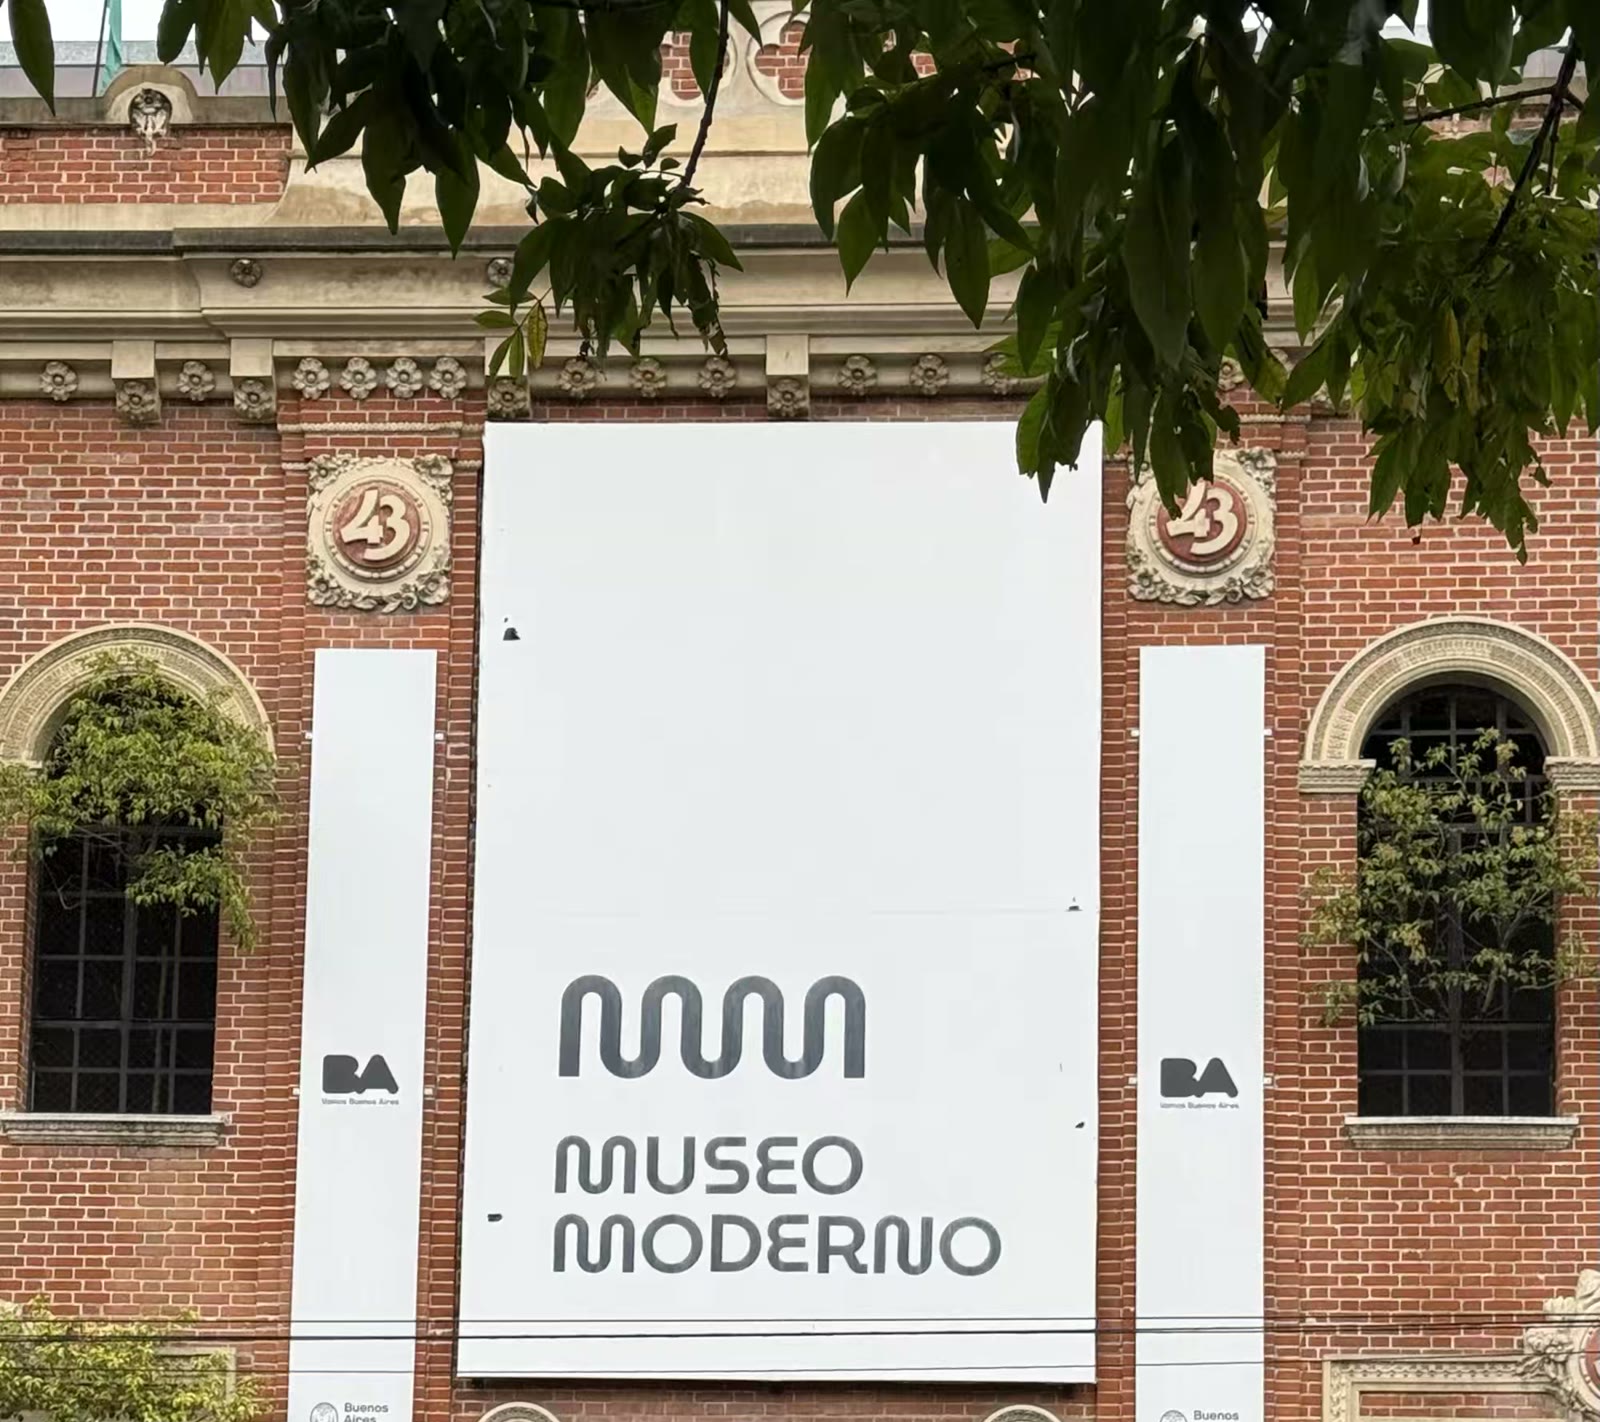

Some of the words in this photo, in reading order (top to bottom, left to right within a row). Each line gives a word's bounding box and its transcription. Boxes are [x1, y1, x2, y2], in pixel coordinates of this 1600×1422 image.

[340, 489, 411, 561] 43
[1165, 476, 1239, 555] 43
[322, 1053, 399, 1094] BA
[1160, 1056, 1239, 1098] BA
[554, 1134, 864, 1196] MUSEO
[552, 1213, 1003, 1278] MODERNO
[344, 1401, 389, 1413] Buenos
[1193, 1409, 1239, 1421] Buenos
